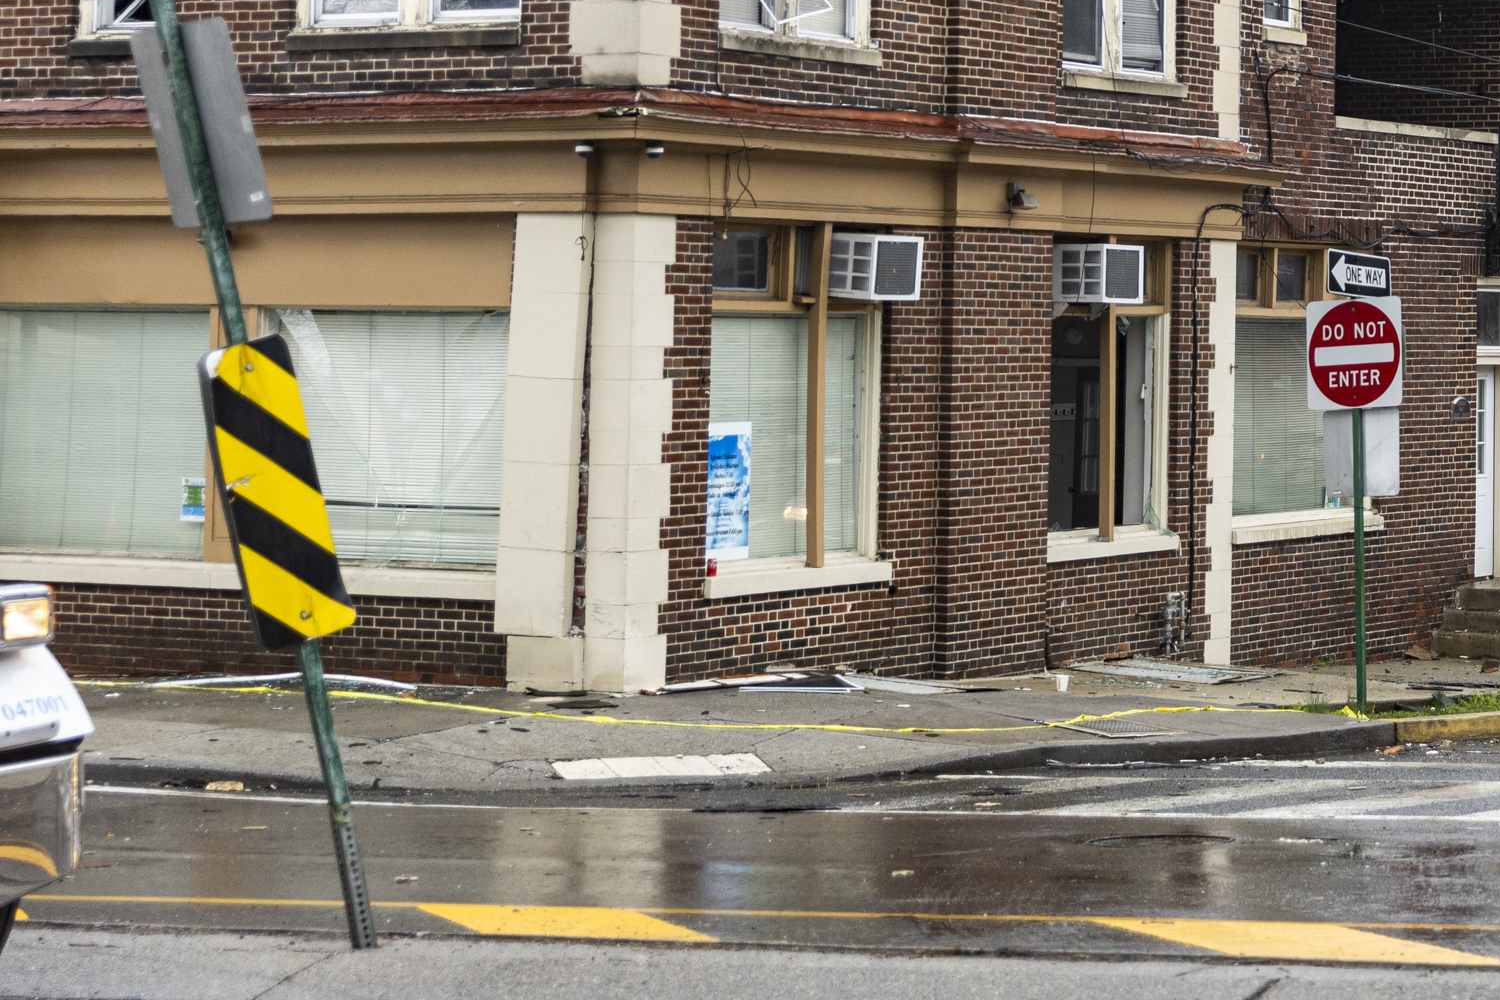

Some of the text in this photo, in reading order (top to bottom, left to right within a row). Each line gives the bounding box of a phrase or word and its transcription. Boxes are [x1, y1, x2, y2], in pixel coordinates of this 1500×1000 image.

[1345, 266, 1383, 286] ONE WAY
[1322, 320, 1386, 341] DO NOT
[1329, 368, 1380, 388] ENTER
[1, 695, 68, 721] 047001
